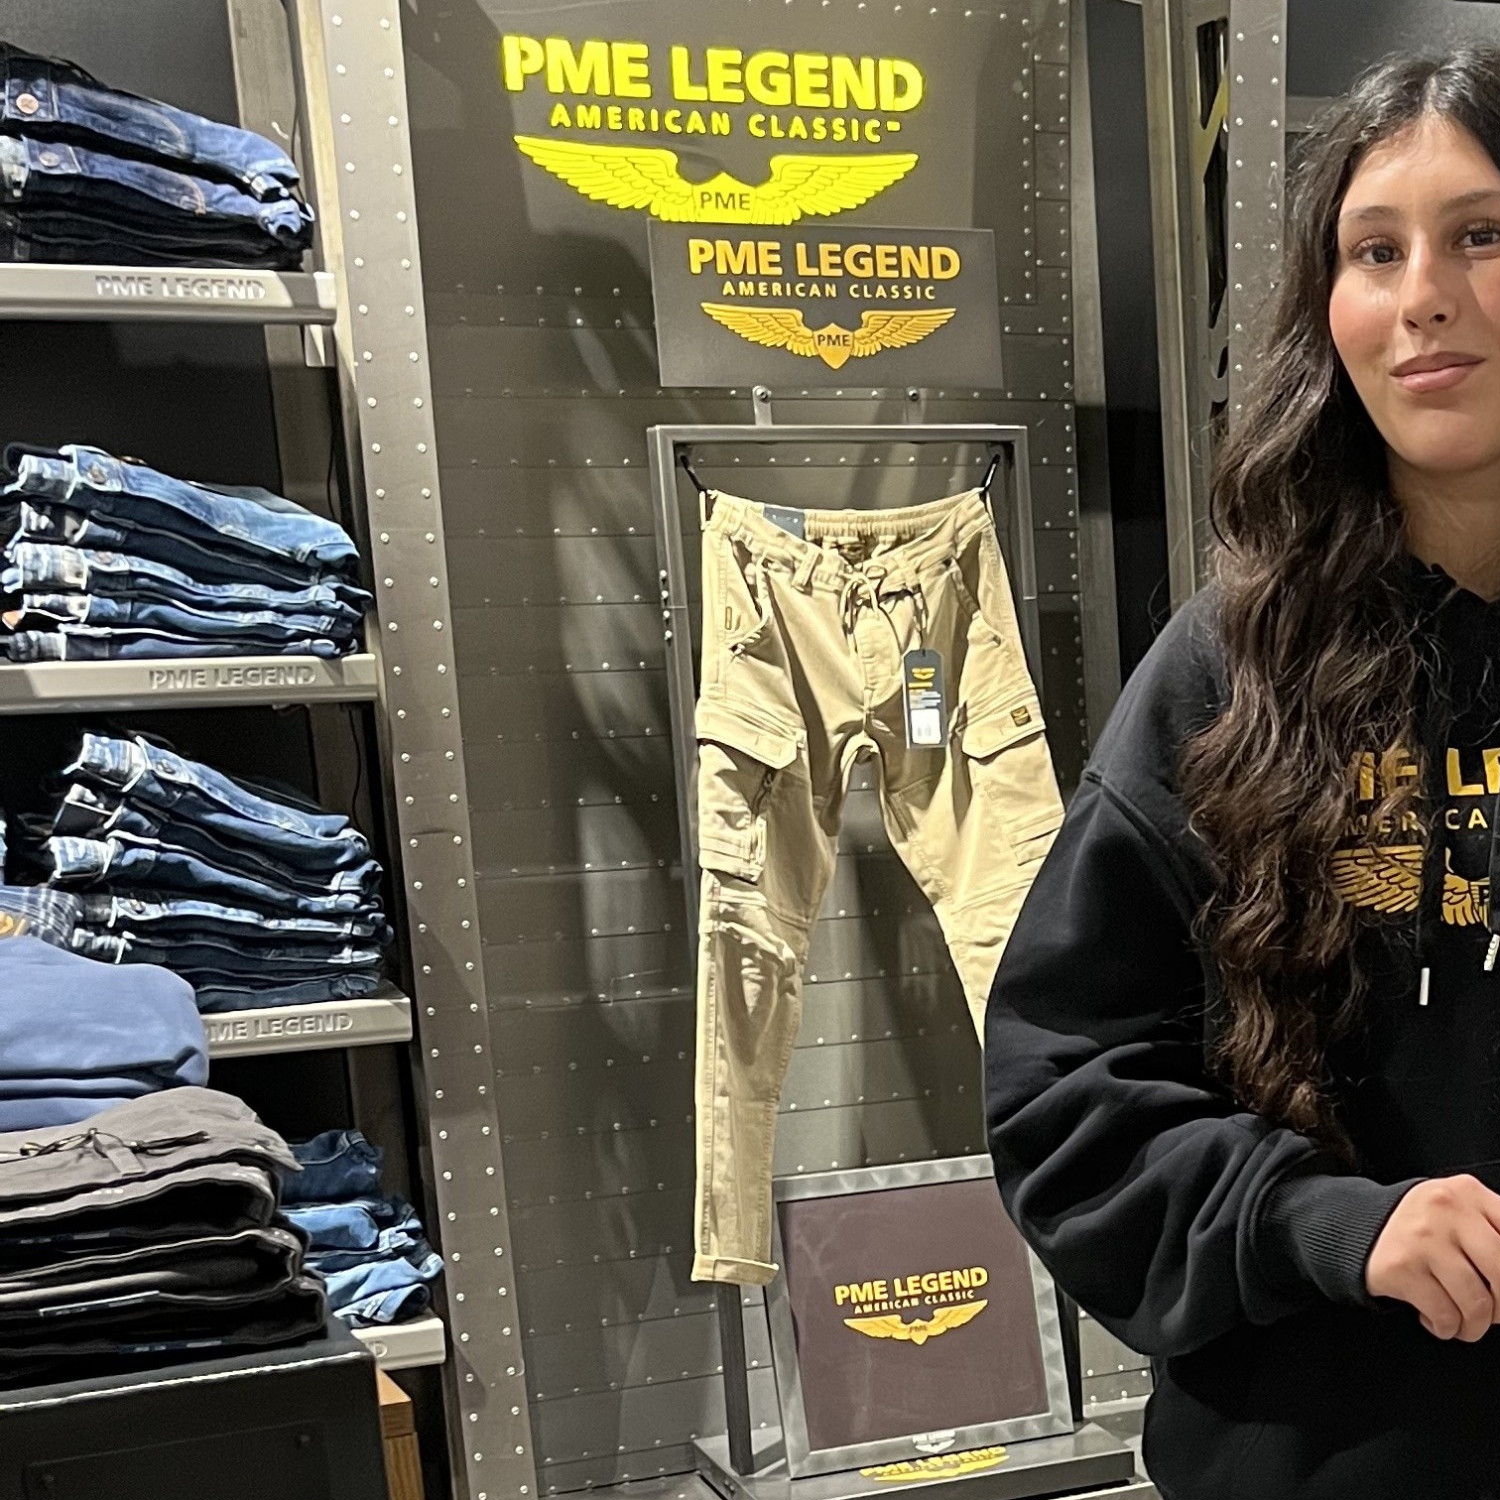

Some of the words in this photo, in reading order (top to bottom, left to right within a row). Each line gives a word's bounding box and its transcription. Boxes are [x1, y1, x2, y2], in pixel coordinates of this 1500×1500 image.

[503, 35, 652, 98] PME
[671, 46, 924, 112] LEGEND
[550, 103, 730, 135] AMERICAN
[699, 190, 751, 211] PME
[688, 238, 783, 275] PME
[796, 243, 961, 279] LEGEND
[95, 275, 152, 297] PME
[160, 277, 266, 300] LEGEND
[722, 280, 837, 298] AMERICAN
[849, 284, 935, 300] CLASSIC
[817, 333, 850, 347] PME
[150, 668, 207, 690] PME
[214, 665, 316, 688] LEGEND
[204, 1021, 248, 1042] ME
[254, 1013, 353, 1038] LEGEND
[834, 1280, 889, 1306] PME
[893, 1266, 988, 1298] LEGEND
[853, 1297, 920, 1314] AMERICAN
[924, 1289, 975, 1305] CLASSIC
